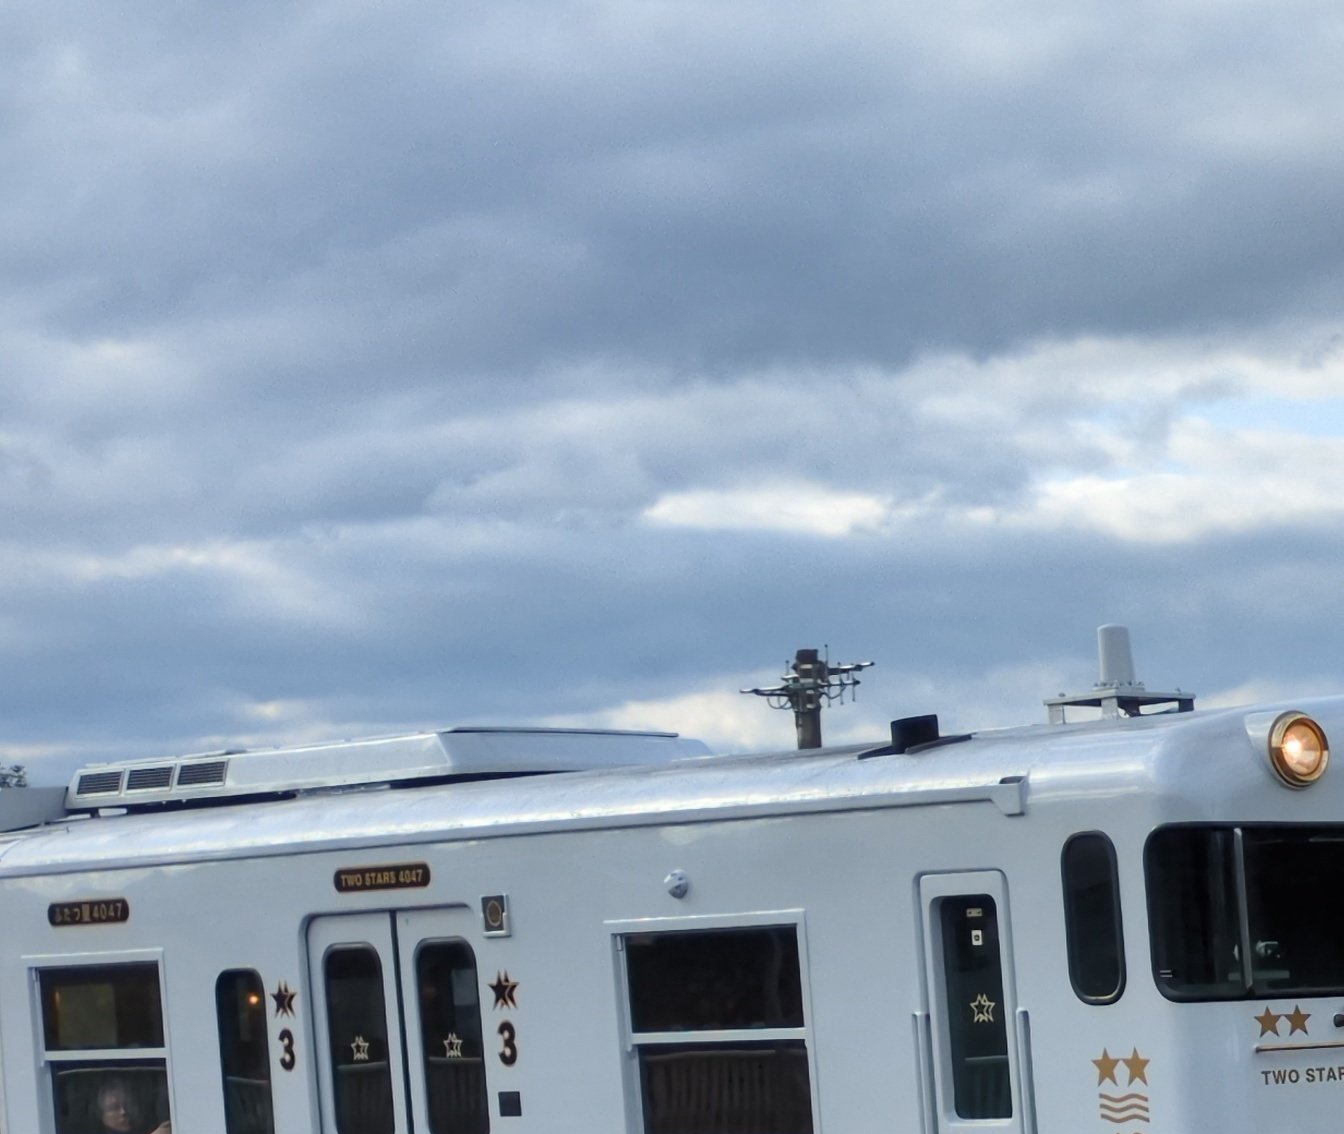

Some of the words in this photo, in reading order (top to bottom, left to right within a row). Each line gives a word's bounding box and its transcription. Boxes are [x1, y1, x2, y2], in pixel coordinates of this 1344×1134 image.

[340, 874, 363, 888] TWO
[365, 871, 396, 886] STARS
[398, 869, 424, 884] 4047
[278, 1028, 295, 1072] 3
[497, 1020, 517, 1067] 3
[1261, 1069, 1300, 1086] TWO
